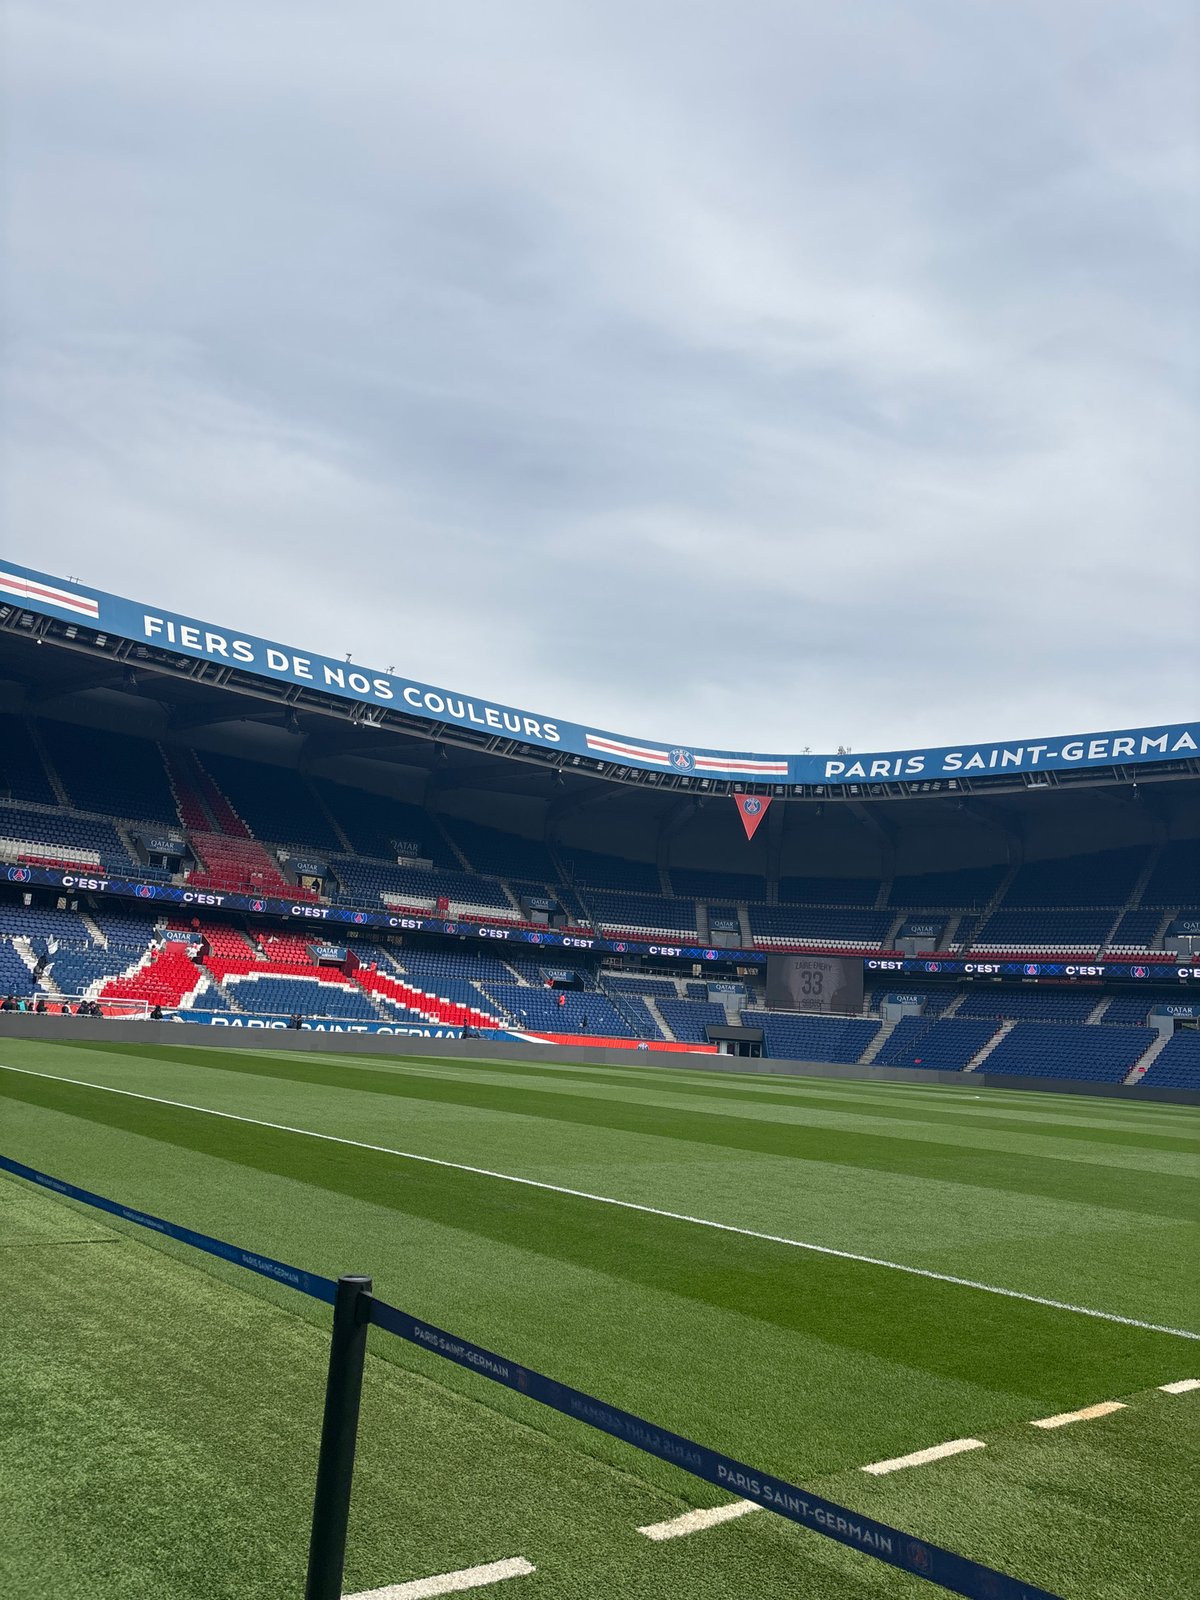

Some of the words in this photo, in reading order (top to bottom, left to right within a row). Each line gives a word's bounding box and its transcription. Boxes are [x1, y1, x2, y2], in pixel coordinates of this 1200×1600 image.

[144, 615, 254, 662] FIERS
[267, 649, 313, 680] DE
[324, 665, 394, 699] NOS
[403, 687, 560, 742] COULEURS
[825, 756, 925, 778] PARIS
[942, 731, 1198, 771] SAINT-GERMA
[151, 839, 175, 850] QATAR
[390, 840, 418, 852] QATAR
[297, 862, 318, 872] QATAR
[62, 876, 108, 891] C'EST
[183, 892, 224, 906] C'EST
[531, 898, 549, 906] QATAR
[291, 905, 329, 919] C'EST
[389, 917, 423, 930] C'EST
[714, 920, 734, 928] QATAR
[911, 925, 934, 933] QATAR
[166, 931, 191, 942] QATAR
[478, 928, 510, 939] C'EST
[563, 937, 594, 948] C'EST
[317, 946, 338, 955] QATAR
[649, 946, 682, 957] C'EST
[868, 960, 903, 970] C'EST
[964, 964, 1000, 974] C'EST
[548, 970, 567, 978] QATAR
[1065, 966, 1105, 976] C'EST
[801, 971, 823, 995] 33
[896, 995, 918, 1003] QATAR
[1166, 1006, 1193, 1014] QATAR
[414, 1326, 439, 1347] PARIS
[440, 1338, 509, 1378] SAINT-GERMAIN
[717, 1464, 761, 1495] PARIS
[763, 1485, 892, 1553] SAINT-GERMAIN
